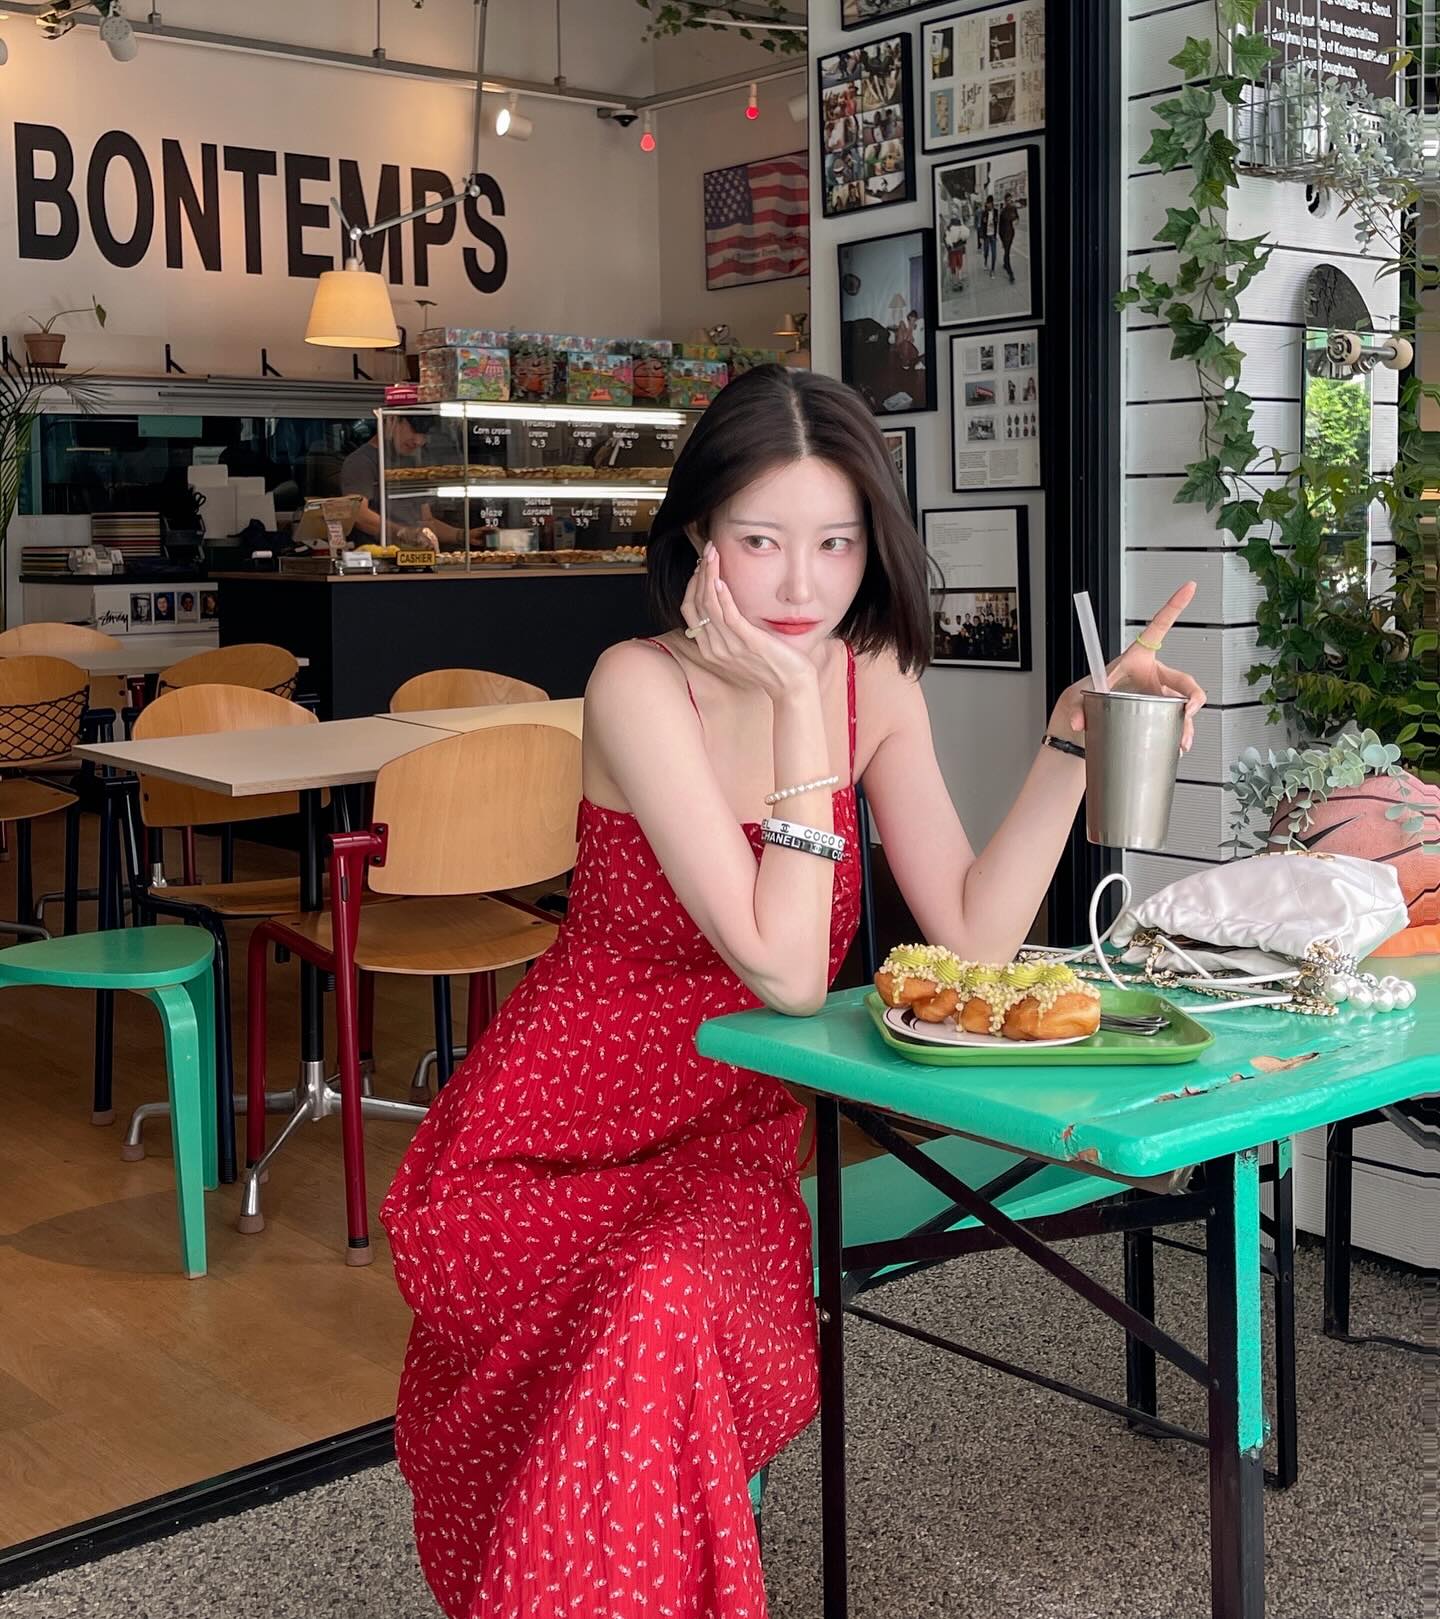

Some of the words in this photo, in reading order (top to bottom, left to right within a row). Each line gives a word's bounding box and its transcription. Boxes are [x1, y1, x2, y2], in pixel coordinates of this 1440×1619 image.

[1372, 1, 1392, 18] Seoul.
[1276, 6, 1282, 20] It
[1290, 12, 1295, 23] a
[1296, 12, 1315, 27] dnut
[1330, 20, 1343, 35] that
[1344, 25, 1379, 43] specializes
[1326, 40, 1333, 53] of
[1334, 41, 1357, 58] Korean
[14, 121, 508, 294] BONTEMPS
[473, 425, 490, 435] Corn
[612, 431, 639, 439] tomato
[485, 436, 500, 446] 4.8
[480, 507, 503, 518] glaze
[522, 506, 553, 516] caramel
[571, 507, 593, 516] Lotus
[612, 507, 637, 516] butter
[485, 518, 499, 527] 3.0
[531, 517, 545, 526] 3.9
[576, 518, 589, 528] 3.9
[619, 517, 632, 526] 3.9
[400, 553, 432, 563] CASHIER
[762, 831, 800, 849] CHANEL
[804, 829, 835, 846] COCO
